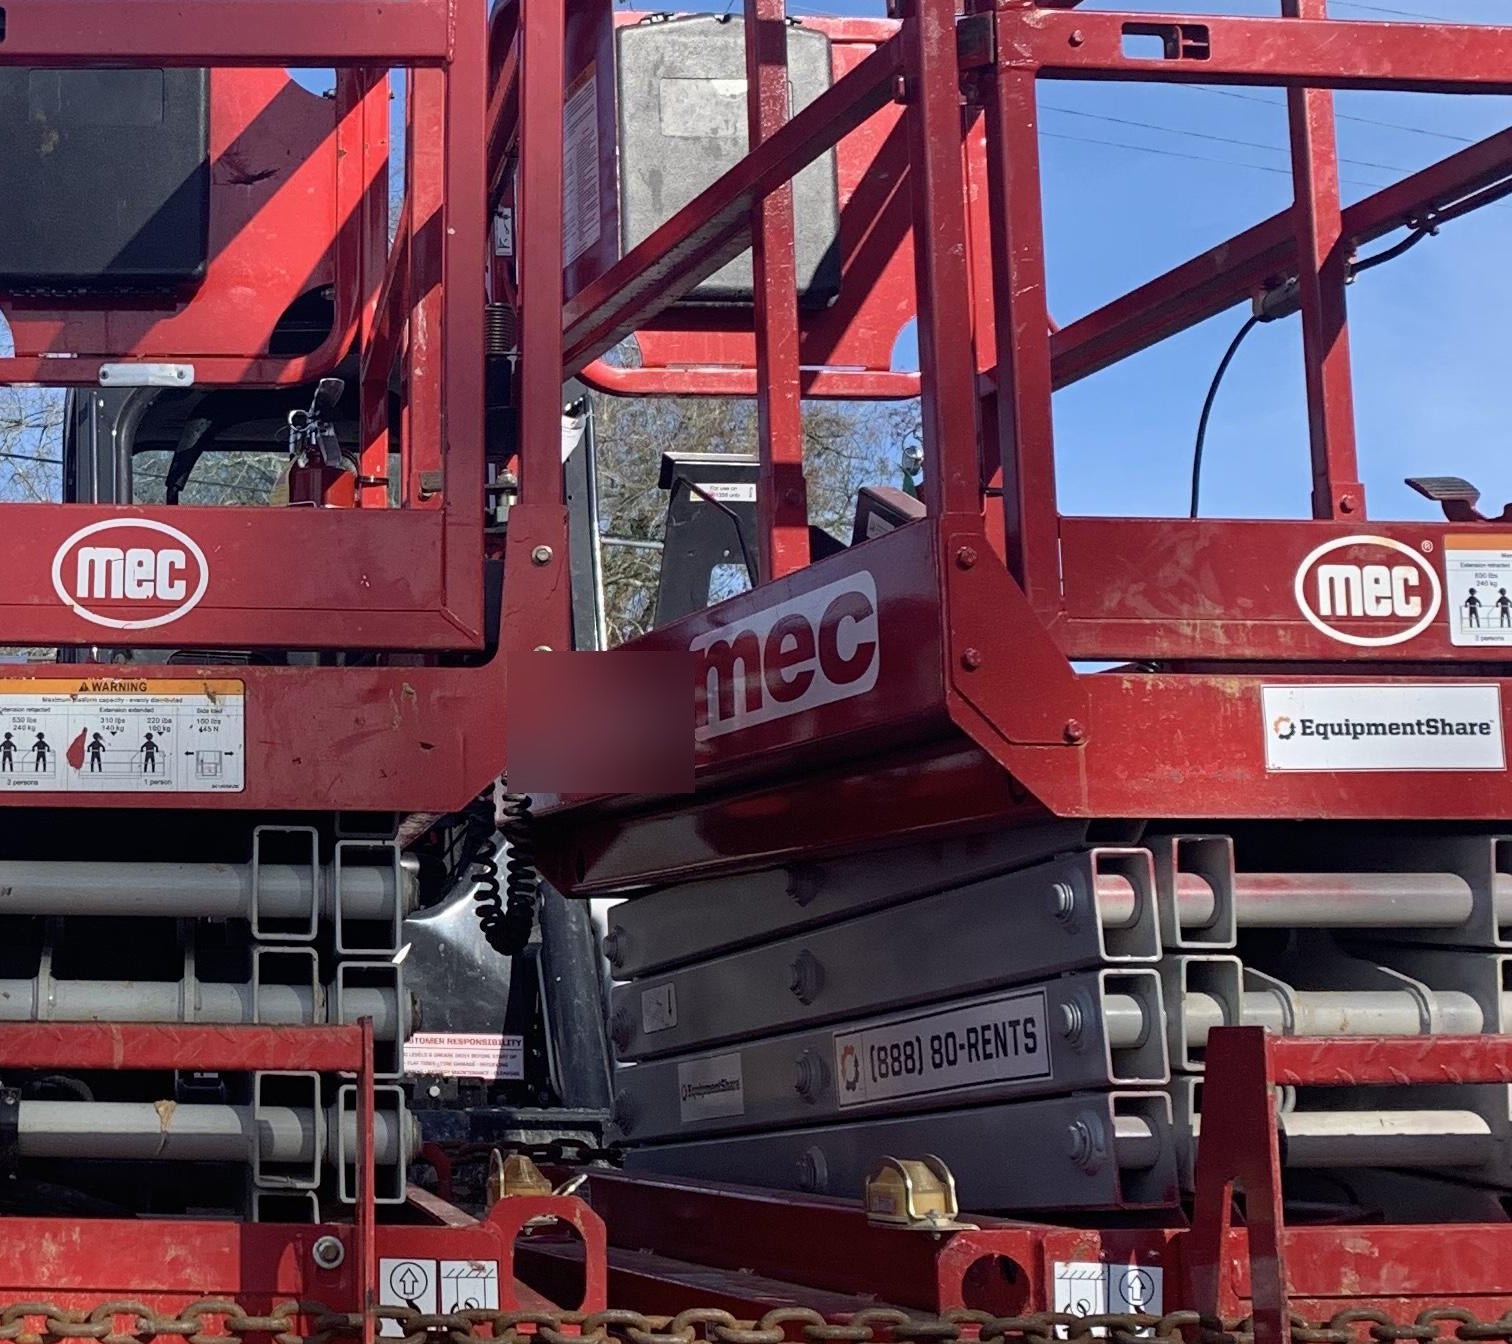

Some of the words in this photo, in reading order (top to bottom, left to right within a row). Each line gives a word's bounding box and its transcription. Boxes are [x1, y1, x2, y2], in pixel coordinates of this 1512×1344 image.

[76, 546, 187, 601] mec
[1317, 564, 1422, 617] mec
[694, 590, 877, 729] mec
[91, 682, 148, 693] WARNING
[1299, 718, 1492, 740] EquipmentShare
[446, 1037, 522, 1047] RESPONSIBILITY
[870, 1035, 924, 1083] (888)
[931, 1017, 1038, 1069] 80-RENTS
